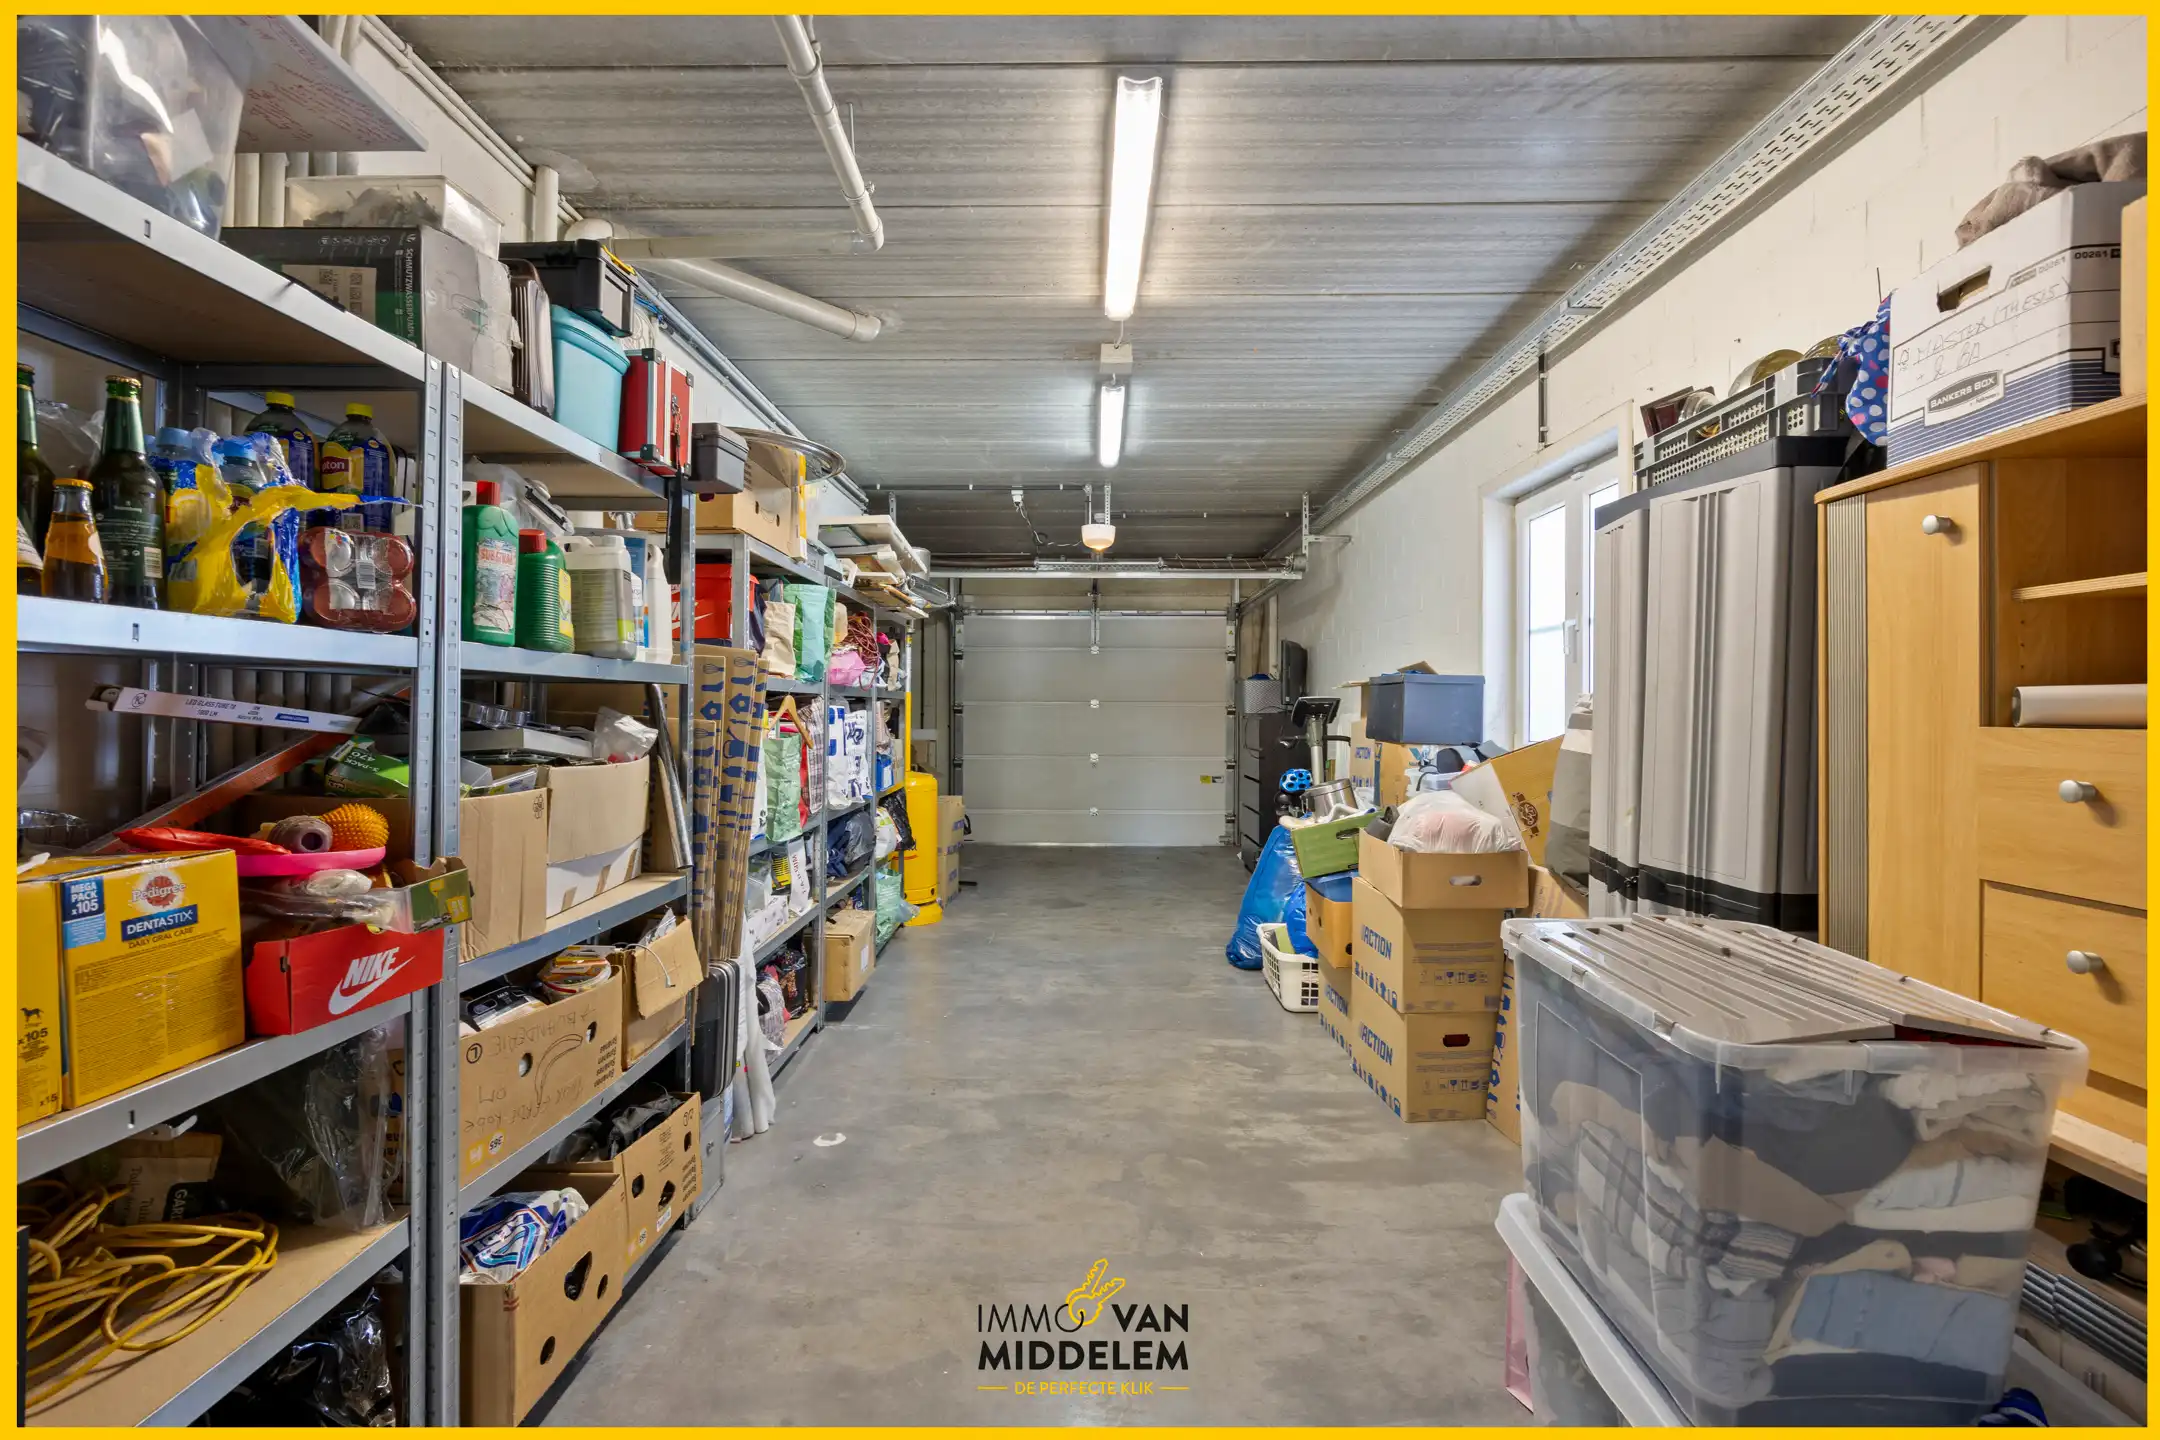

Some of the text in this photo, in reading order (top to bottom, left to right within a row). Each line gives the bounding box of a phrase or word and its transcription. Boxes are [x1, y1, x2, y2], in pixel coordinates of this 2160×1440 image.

[2074, 250, 2107, 260] 00261
[1930, 375, 1996, 409] BANKERS BOX
[322, 458, 345, 471] pton
[71, 882, 97, 893] MEGA
[71, 890, 97, 903] PACK
[132, 882, 186, 903] Pedigree
[72, 899, 99, 916] x105
[127, 909, 193, 936] DENTASTIX
[128, 926, 195, 949] DAILY ORAL CARE
[1362, 924, 1392, 961] ACTION
[342, 946, 400, 990] NIKE
[1326, 985, 1348, 1017] ACTION
[1361, 1025, 1393, 1066] ACTION
